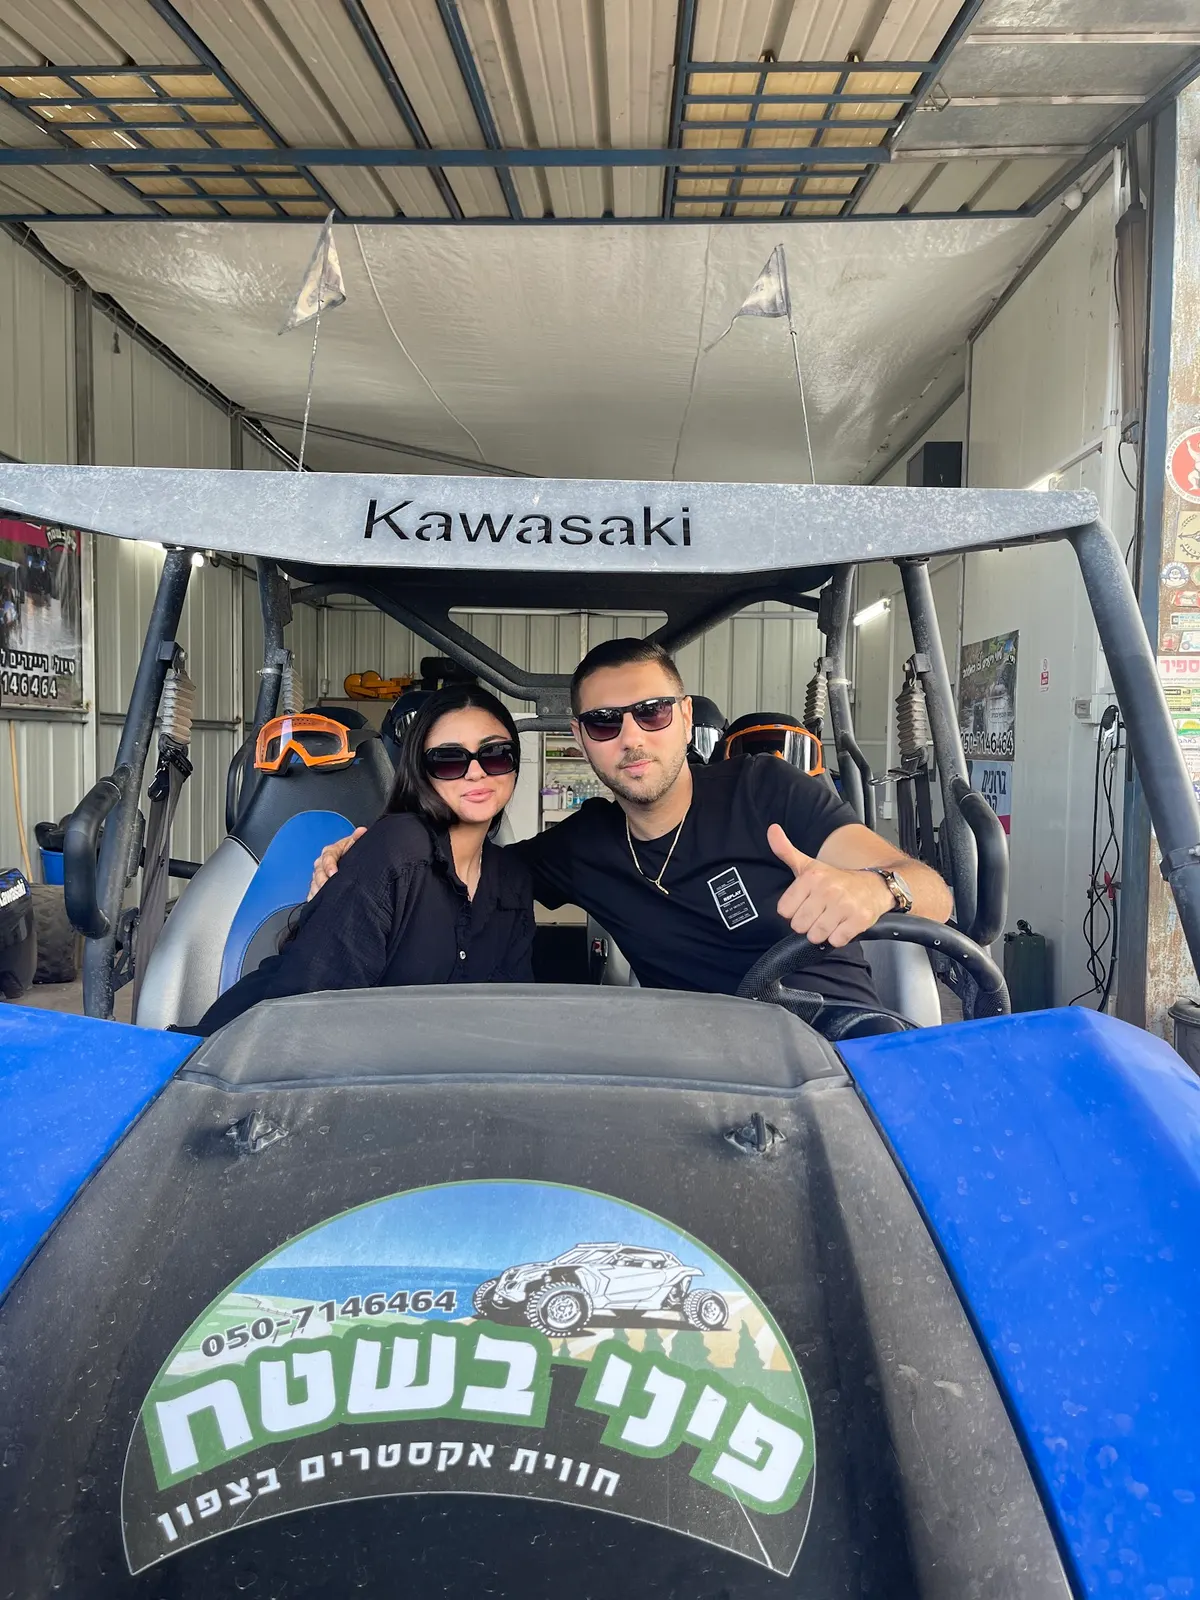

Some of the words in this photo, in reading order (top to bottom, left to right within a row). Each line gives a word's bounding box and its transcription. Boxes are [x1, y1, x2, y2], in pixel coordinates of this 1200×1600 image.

[363, 498, 692, 546] Kawasaki
[0, 673, 57, 698] 146464
[10, 652, 48, 671] רייזרים
[1160, 659, 1200, 673] ספיר
[201, 1290, 456, 1357] 050-7146464
[153, 1334, 538, 1475] בשטח
[595, 1354, 803, 1502] פיני
[300, 1441, 494, 1483] אקסטרים
[509, 1448, 620, 1497] חווית
[157, 1467, 281, 1542] בצפון
